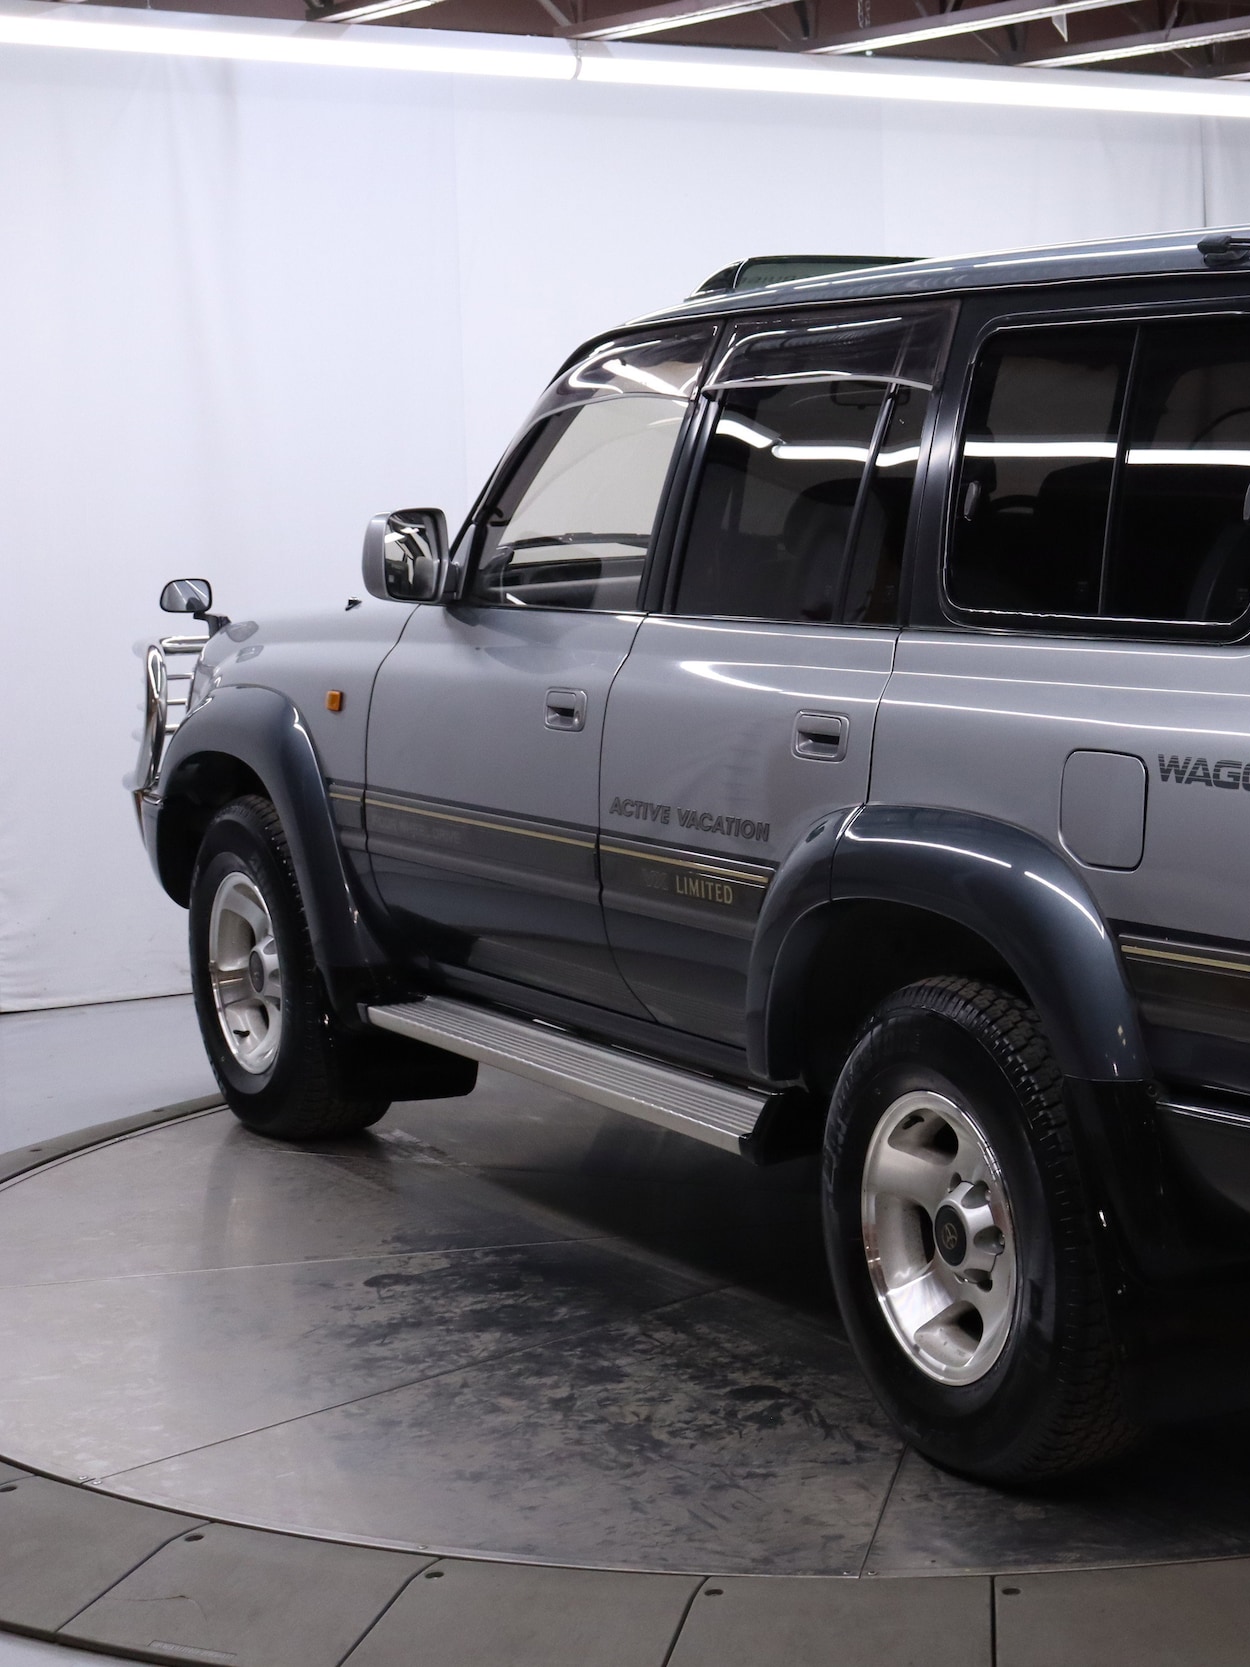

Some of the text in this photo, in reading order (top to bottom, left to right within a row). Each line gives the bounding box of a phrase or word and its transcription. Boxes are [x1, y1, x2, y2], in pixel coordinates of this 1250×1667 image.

[608, 796, 771, 843] ACTIVE VACATION
[675, 873, 734, 905] LIMITED
